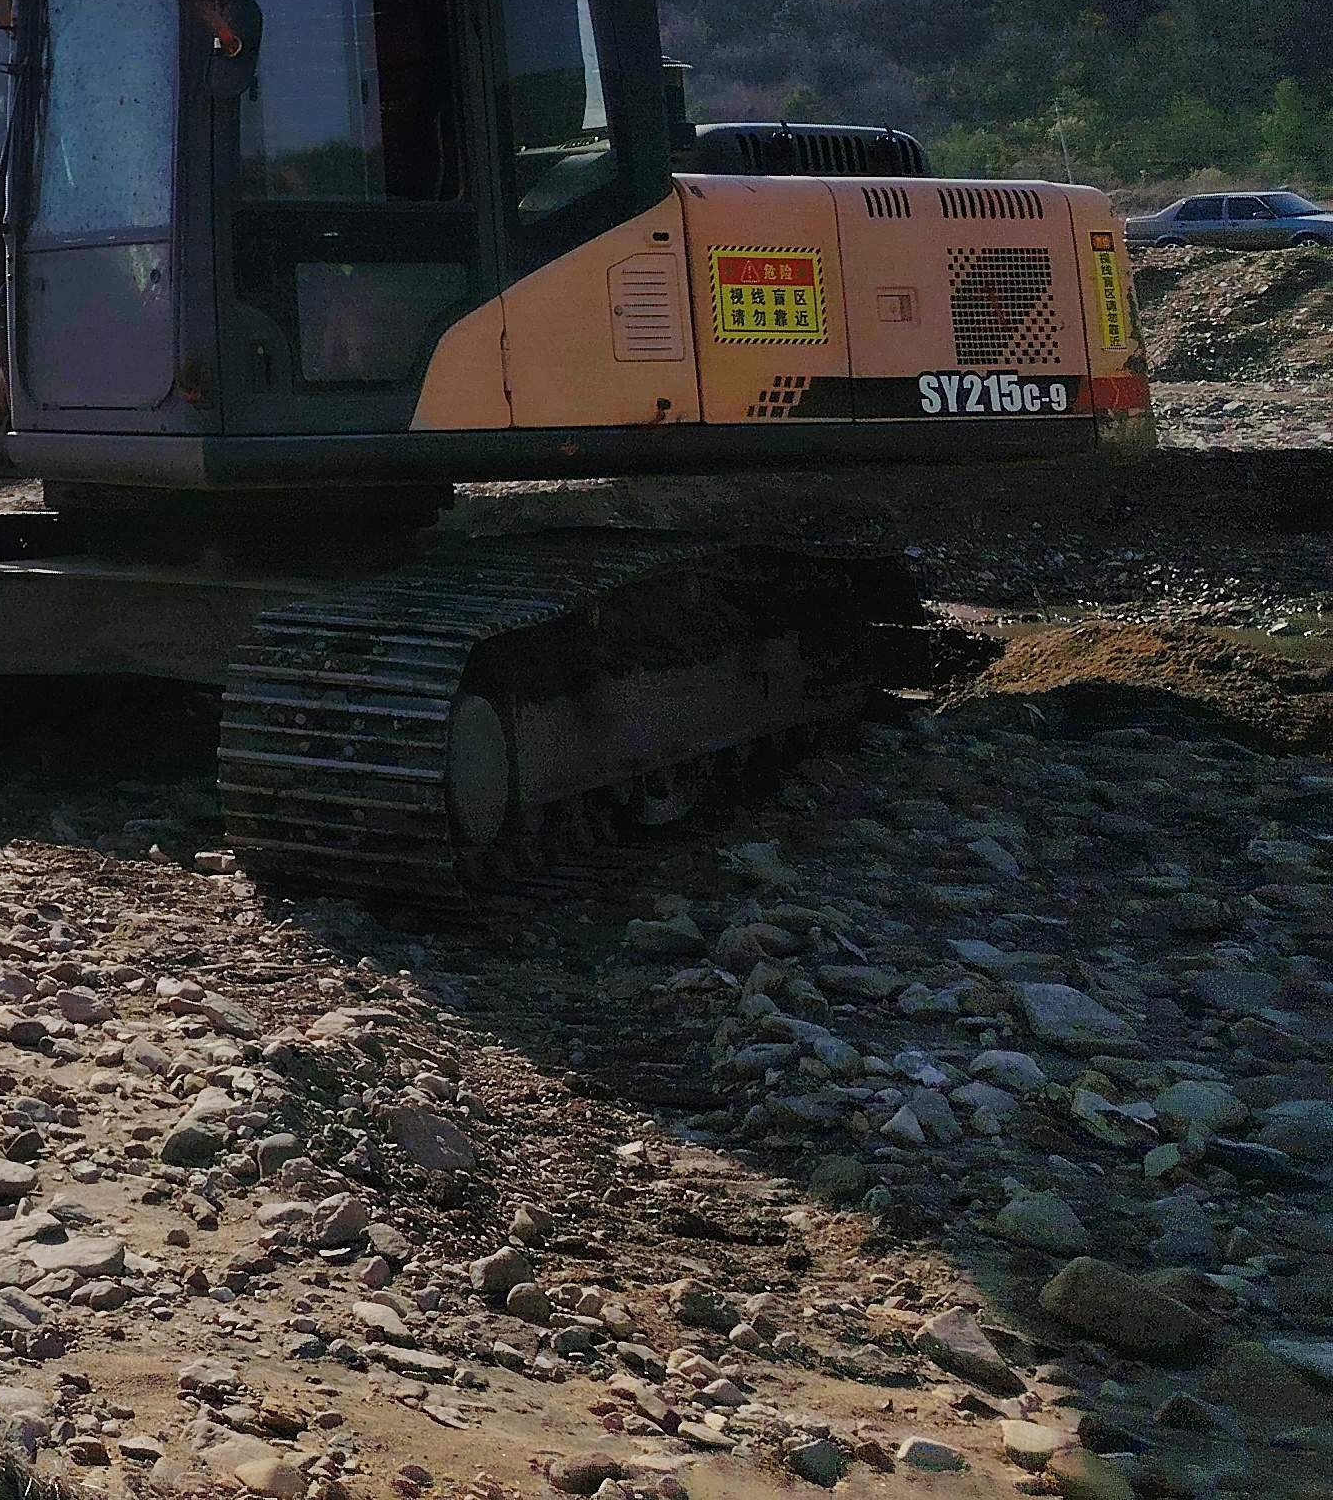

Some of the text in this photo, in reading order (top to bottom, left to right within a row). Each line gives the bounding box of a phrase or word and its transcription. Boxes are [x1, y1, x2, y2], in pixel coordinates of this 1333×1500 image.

[763, 263, 793, 280] 危险
[729, 288, 807, 306] 视线盲区
[731, 309, 810, 327] 请勿靠近
